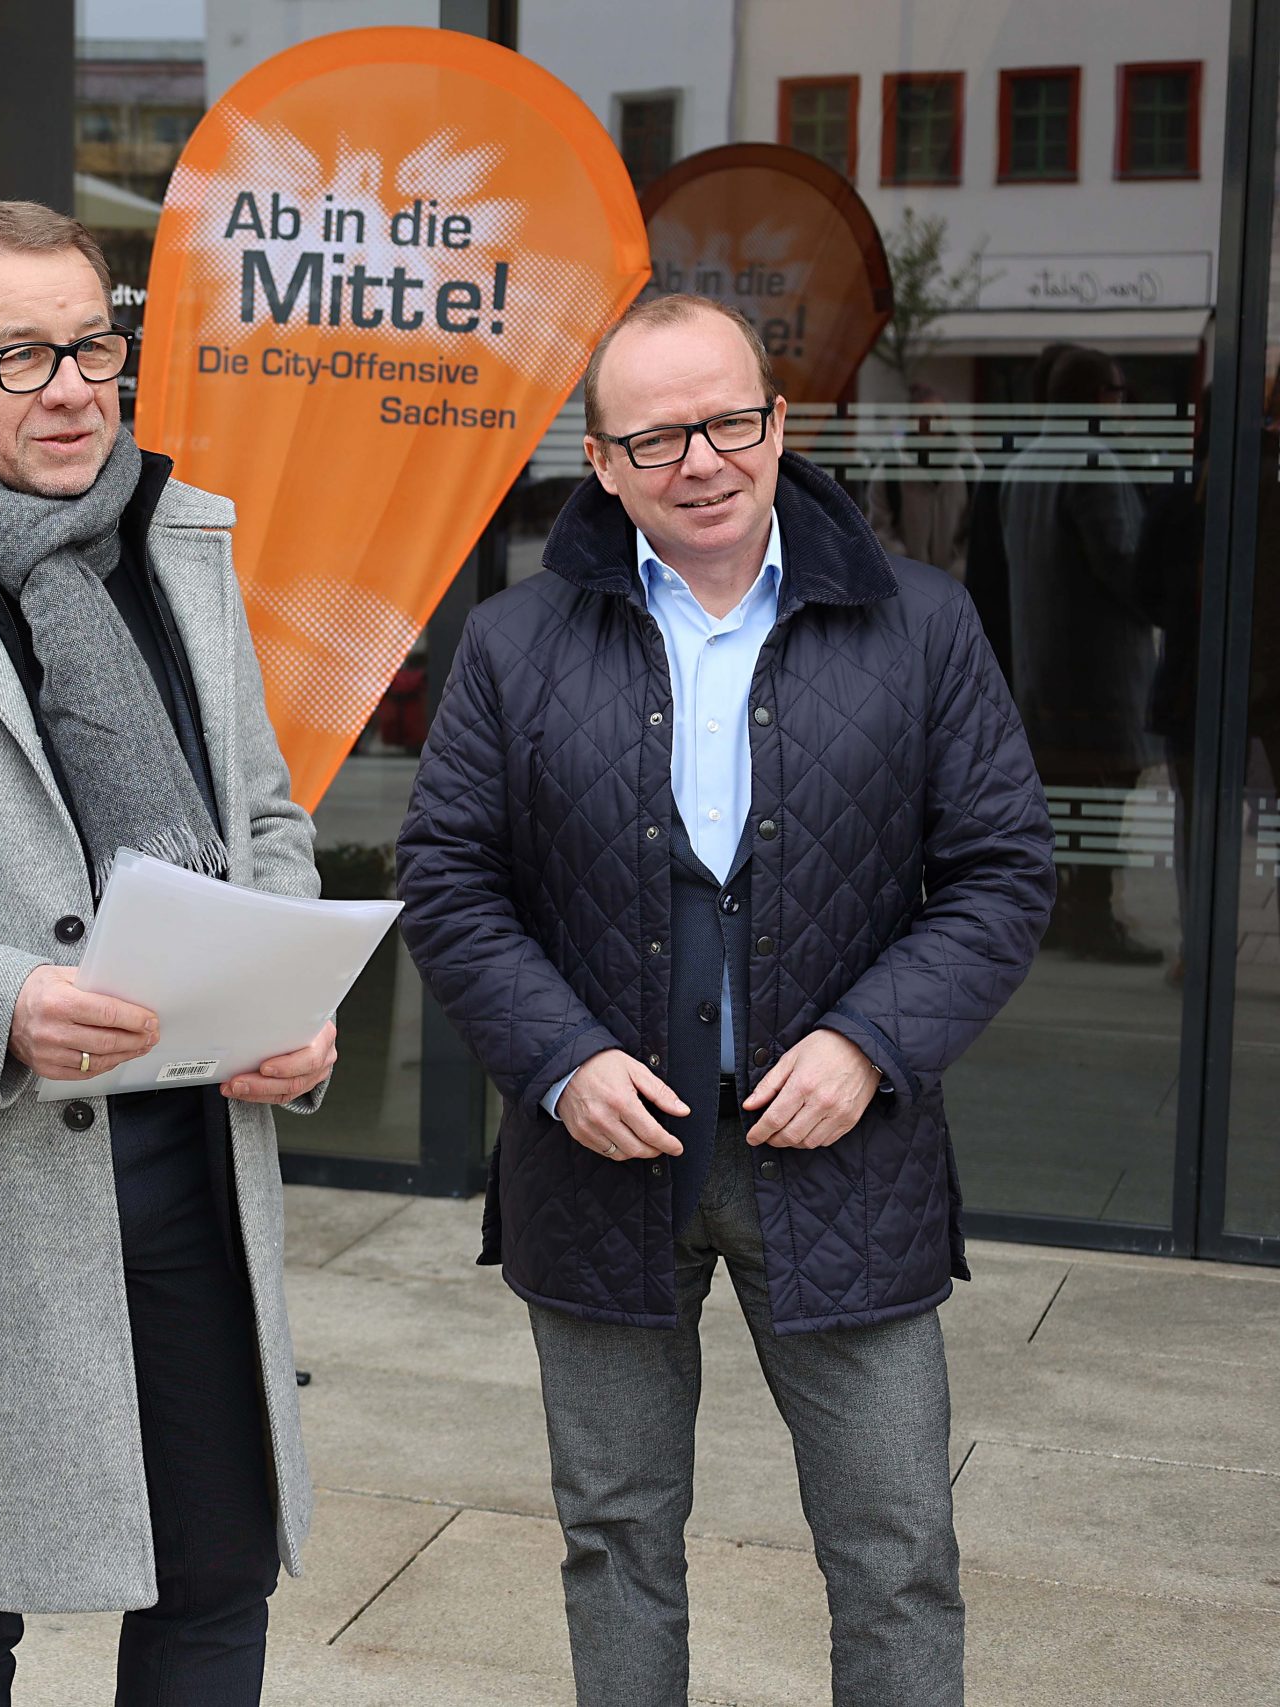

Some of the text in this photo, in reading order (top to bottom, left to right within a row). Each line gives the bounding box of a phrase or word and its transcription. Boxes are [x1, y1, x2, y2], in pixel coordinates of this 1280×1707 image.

[224, 191, 472, 249] Ab in die
[240, 250, 509, 335] Mitte!
[736, 264, 785, 297] die
[198, 345, 479, 385] Die City-Offensive
[380, 396, 516, 429] Sachsen
